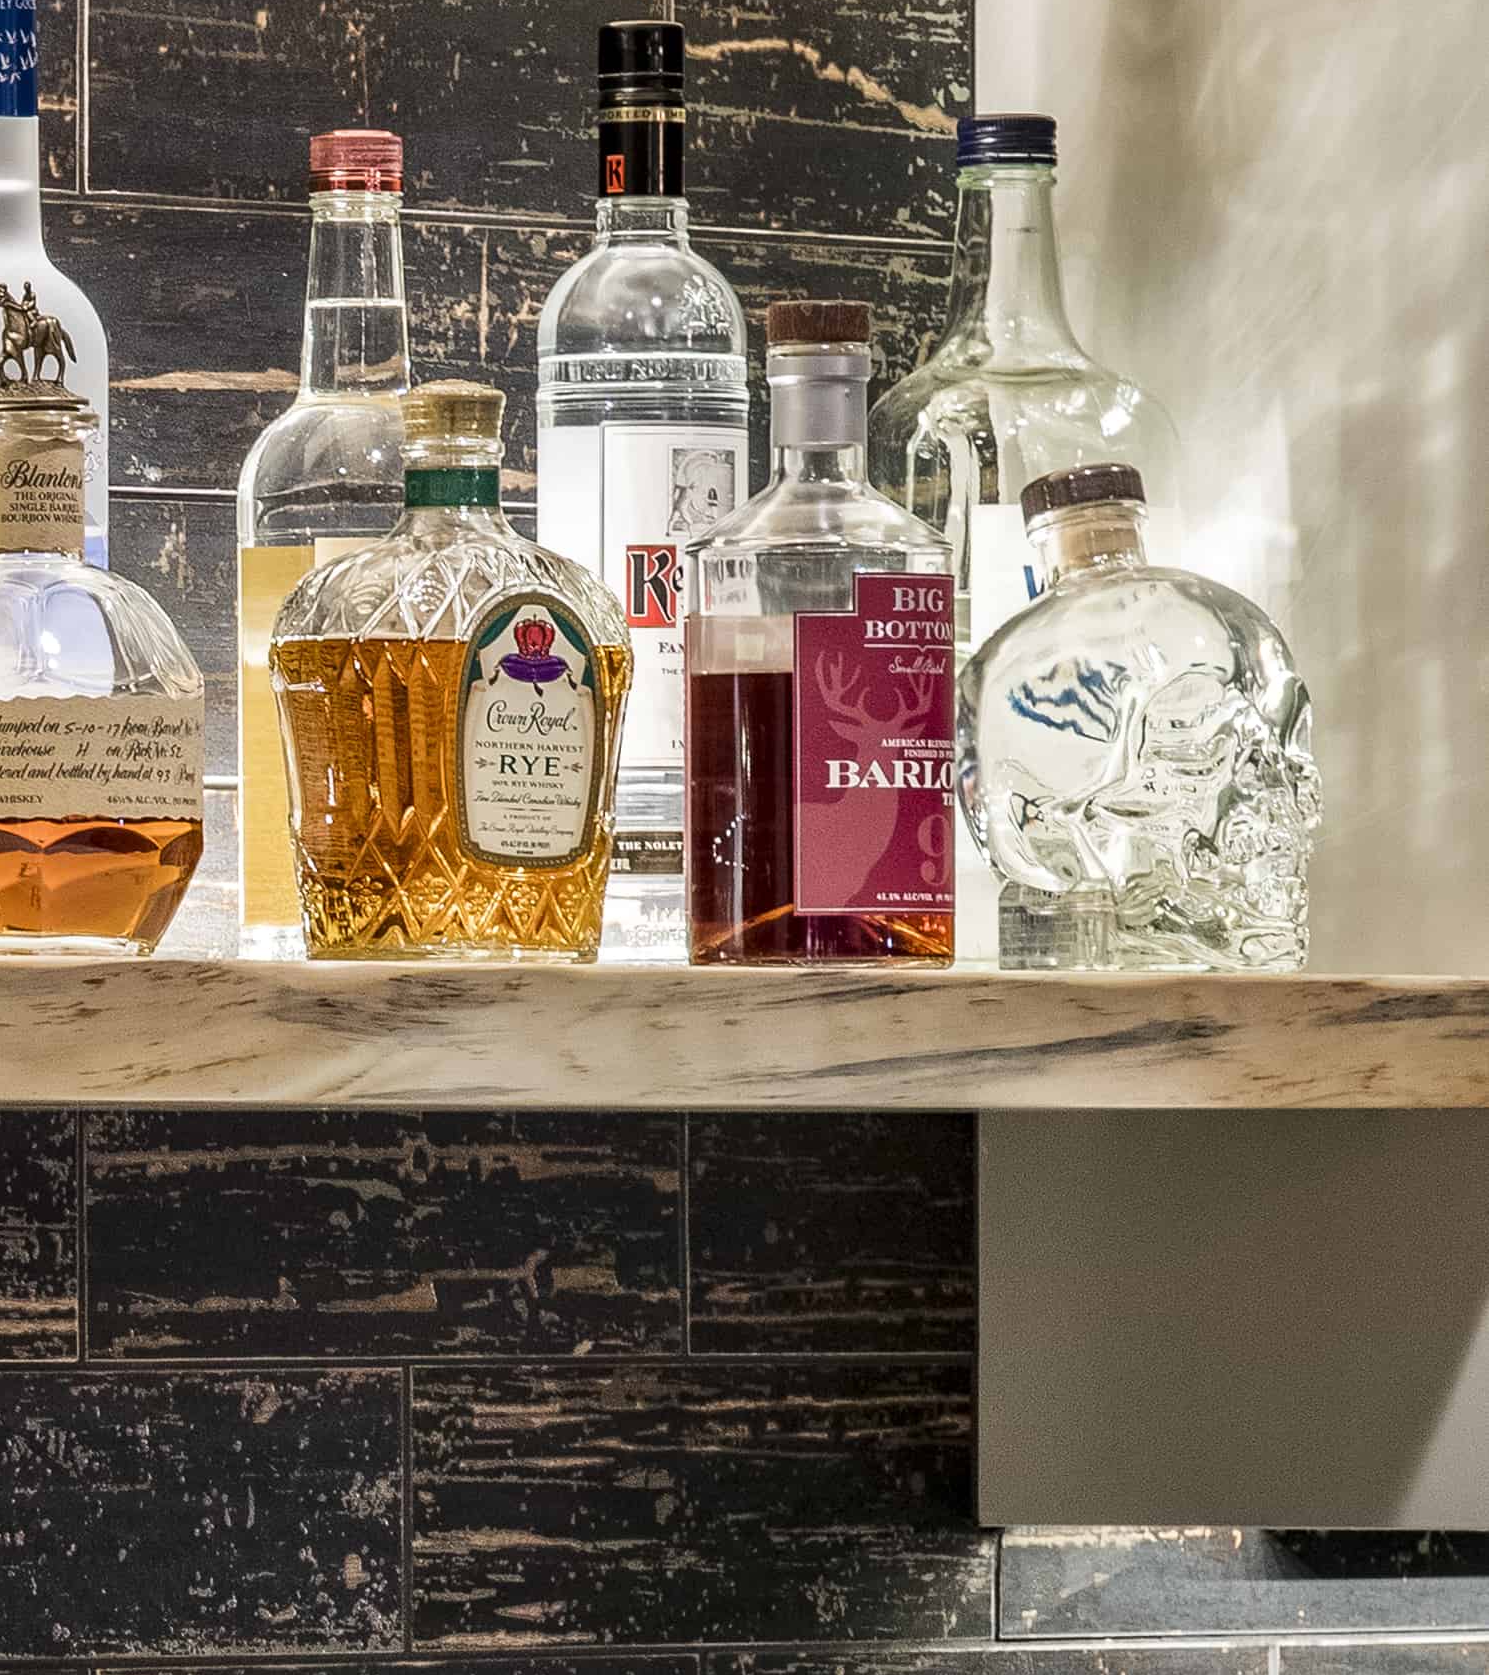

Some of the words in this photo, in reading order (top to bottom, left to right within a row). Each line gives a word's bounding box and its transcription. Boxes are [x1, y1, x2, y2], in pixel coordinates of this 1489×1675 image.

[609, 160, 623, 190] K
[14, 491, 36, 500] THE
[9, 503, 47, 512] SINGLE
[2, 513, 51, 524] BOURBON
[893, 587, 944, 613] BIG
[487, 700, 527, 732] Crown
[518, 701, 568, 736] Royal
[476, 740, 533, 751] NORTHERN
[537, 742, 584, 753] HARVEST
[499, 754, 560, 776] RYE
[825, 760, 954, 789] BARLO
[530, 781, 564, 789] WHISKY
[617, 840, 641, 851] THE
